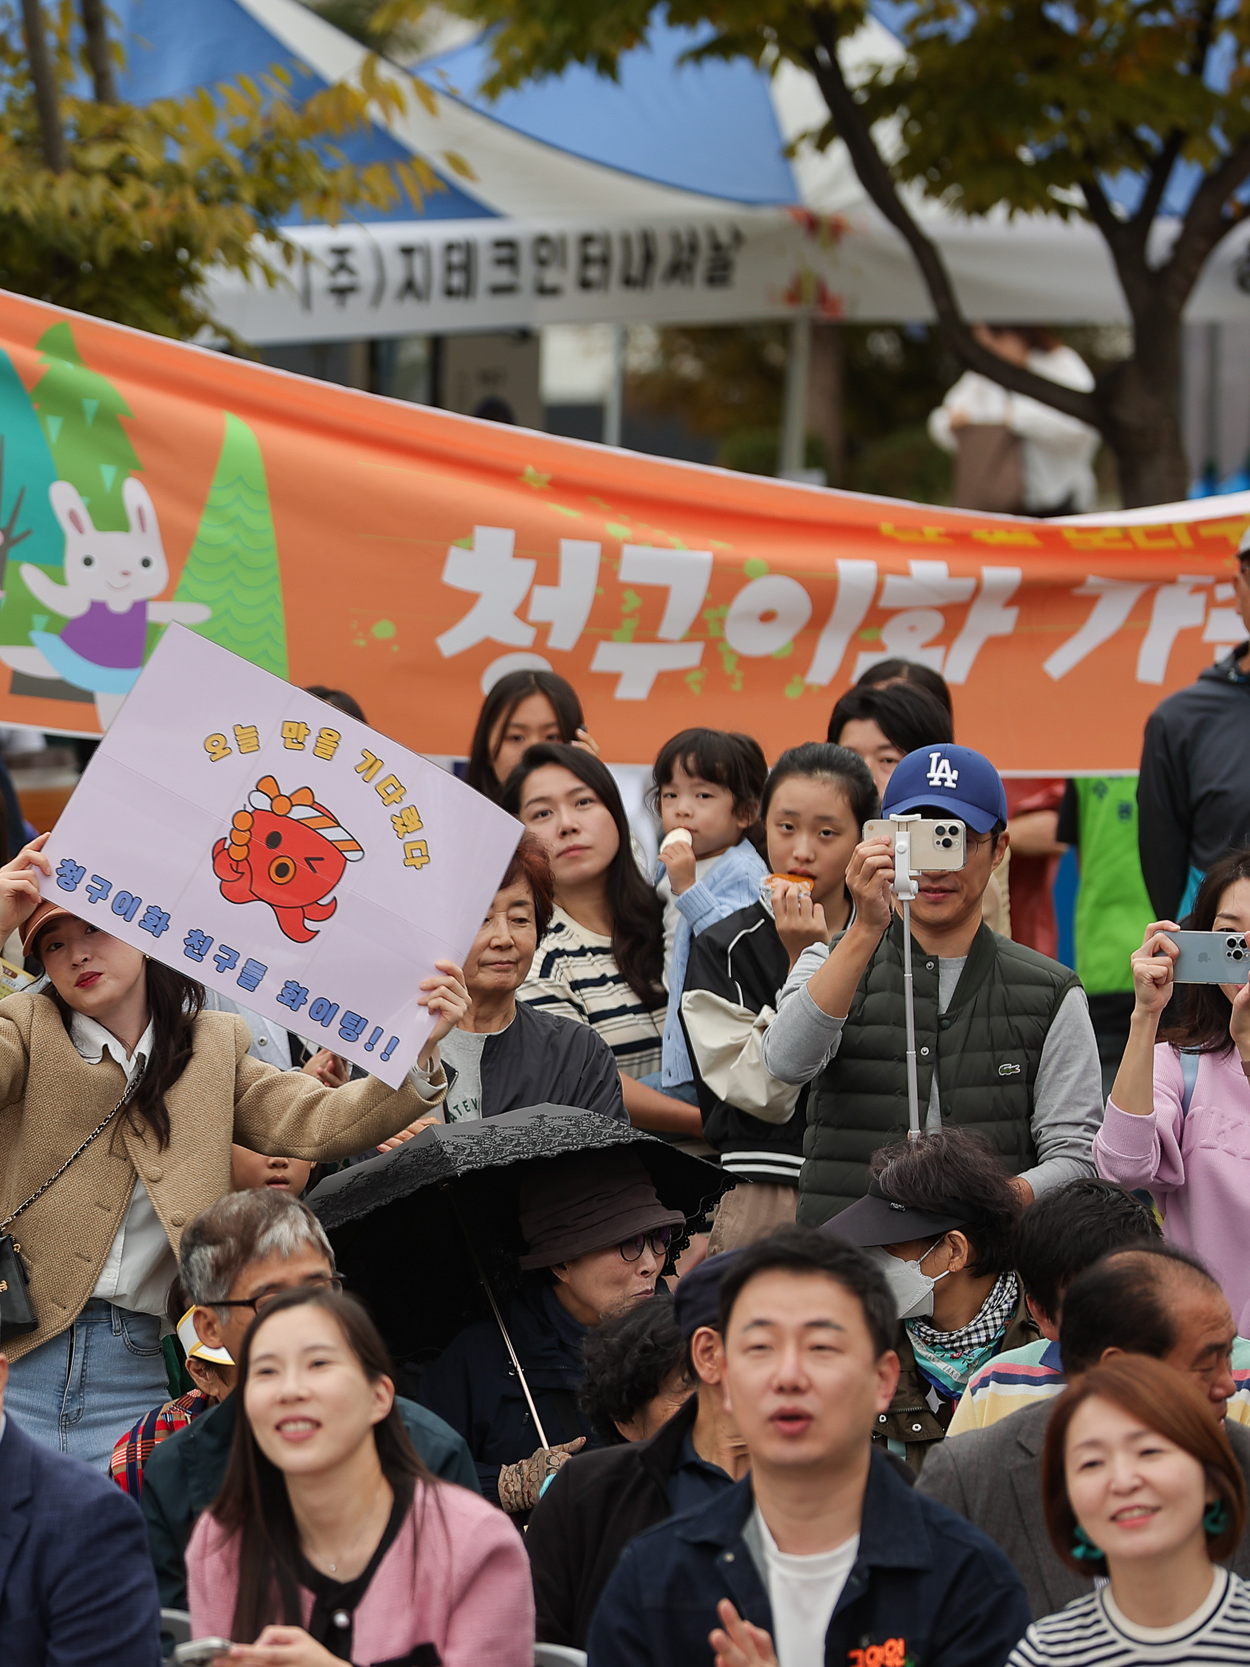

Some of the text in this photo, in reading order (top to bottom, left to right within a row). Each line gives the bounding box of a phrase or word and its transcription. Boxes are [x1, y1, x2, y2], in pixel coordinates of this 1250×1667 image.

[435, 525, 1250, 700] 청구이화 가
[203, 720, 431, 870] 오늘 만을 기다렸다
[926, 751, 959, 789] LA
[55, 858, 400, 1062] 청구이화 친구들 화이팅!!
